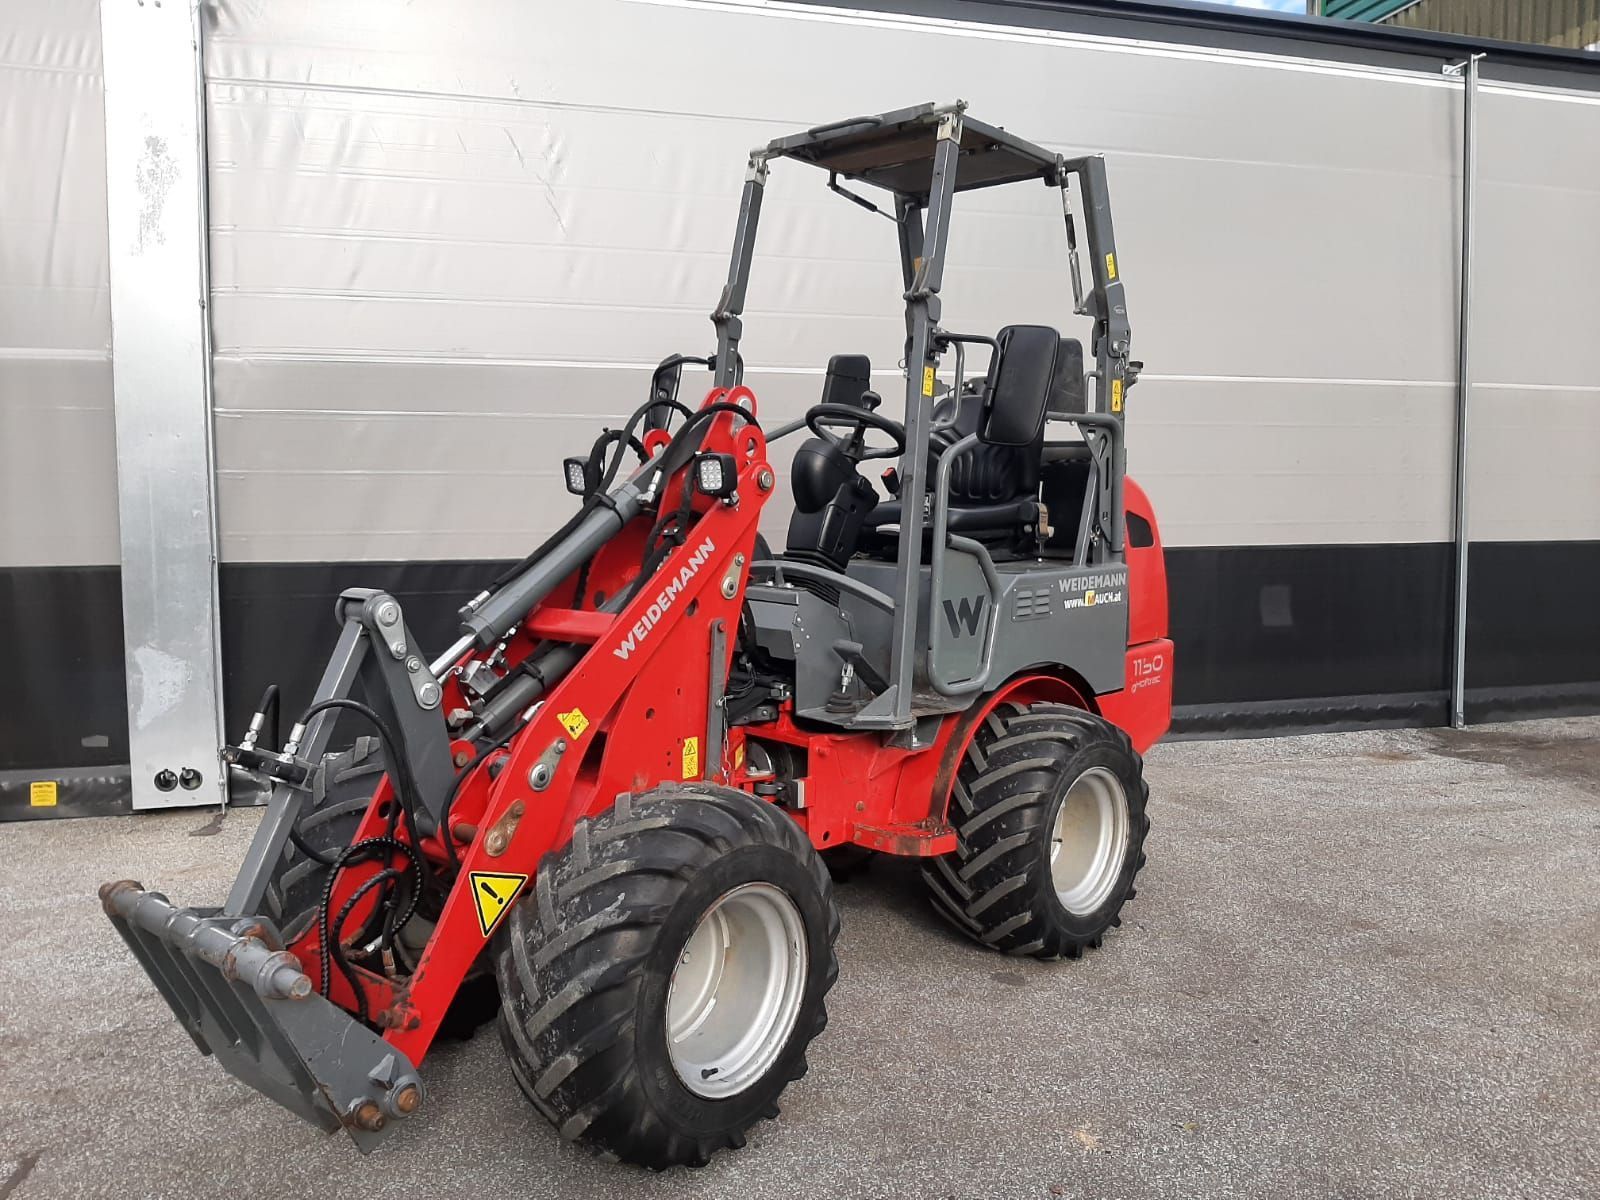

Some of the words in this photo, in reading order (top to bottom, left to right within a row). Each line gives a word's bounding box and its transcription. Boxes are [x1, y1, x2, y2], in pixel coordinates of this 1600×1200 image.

[613, 536, 715, 660] WEIDEMANN
[1059, 573, 1126, 592] WEIDEMANN
[942, 595, 985, 638] W
[1133, 655, 1163, 676] 1150
